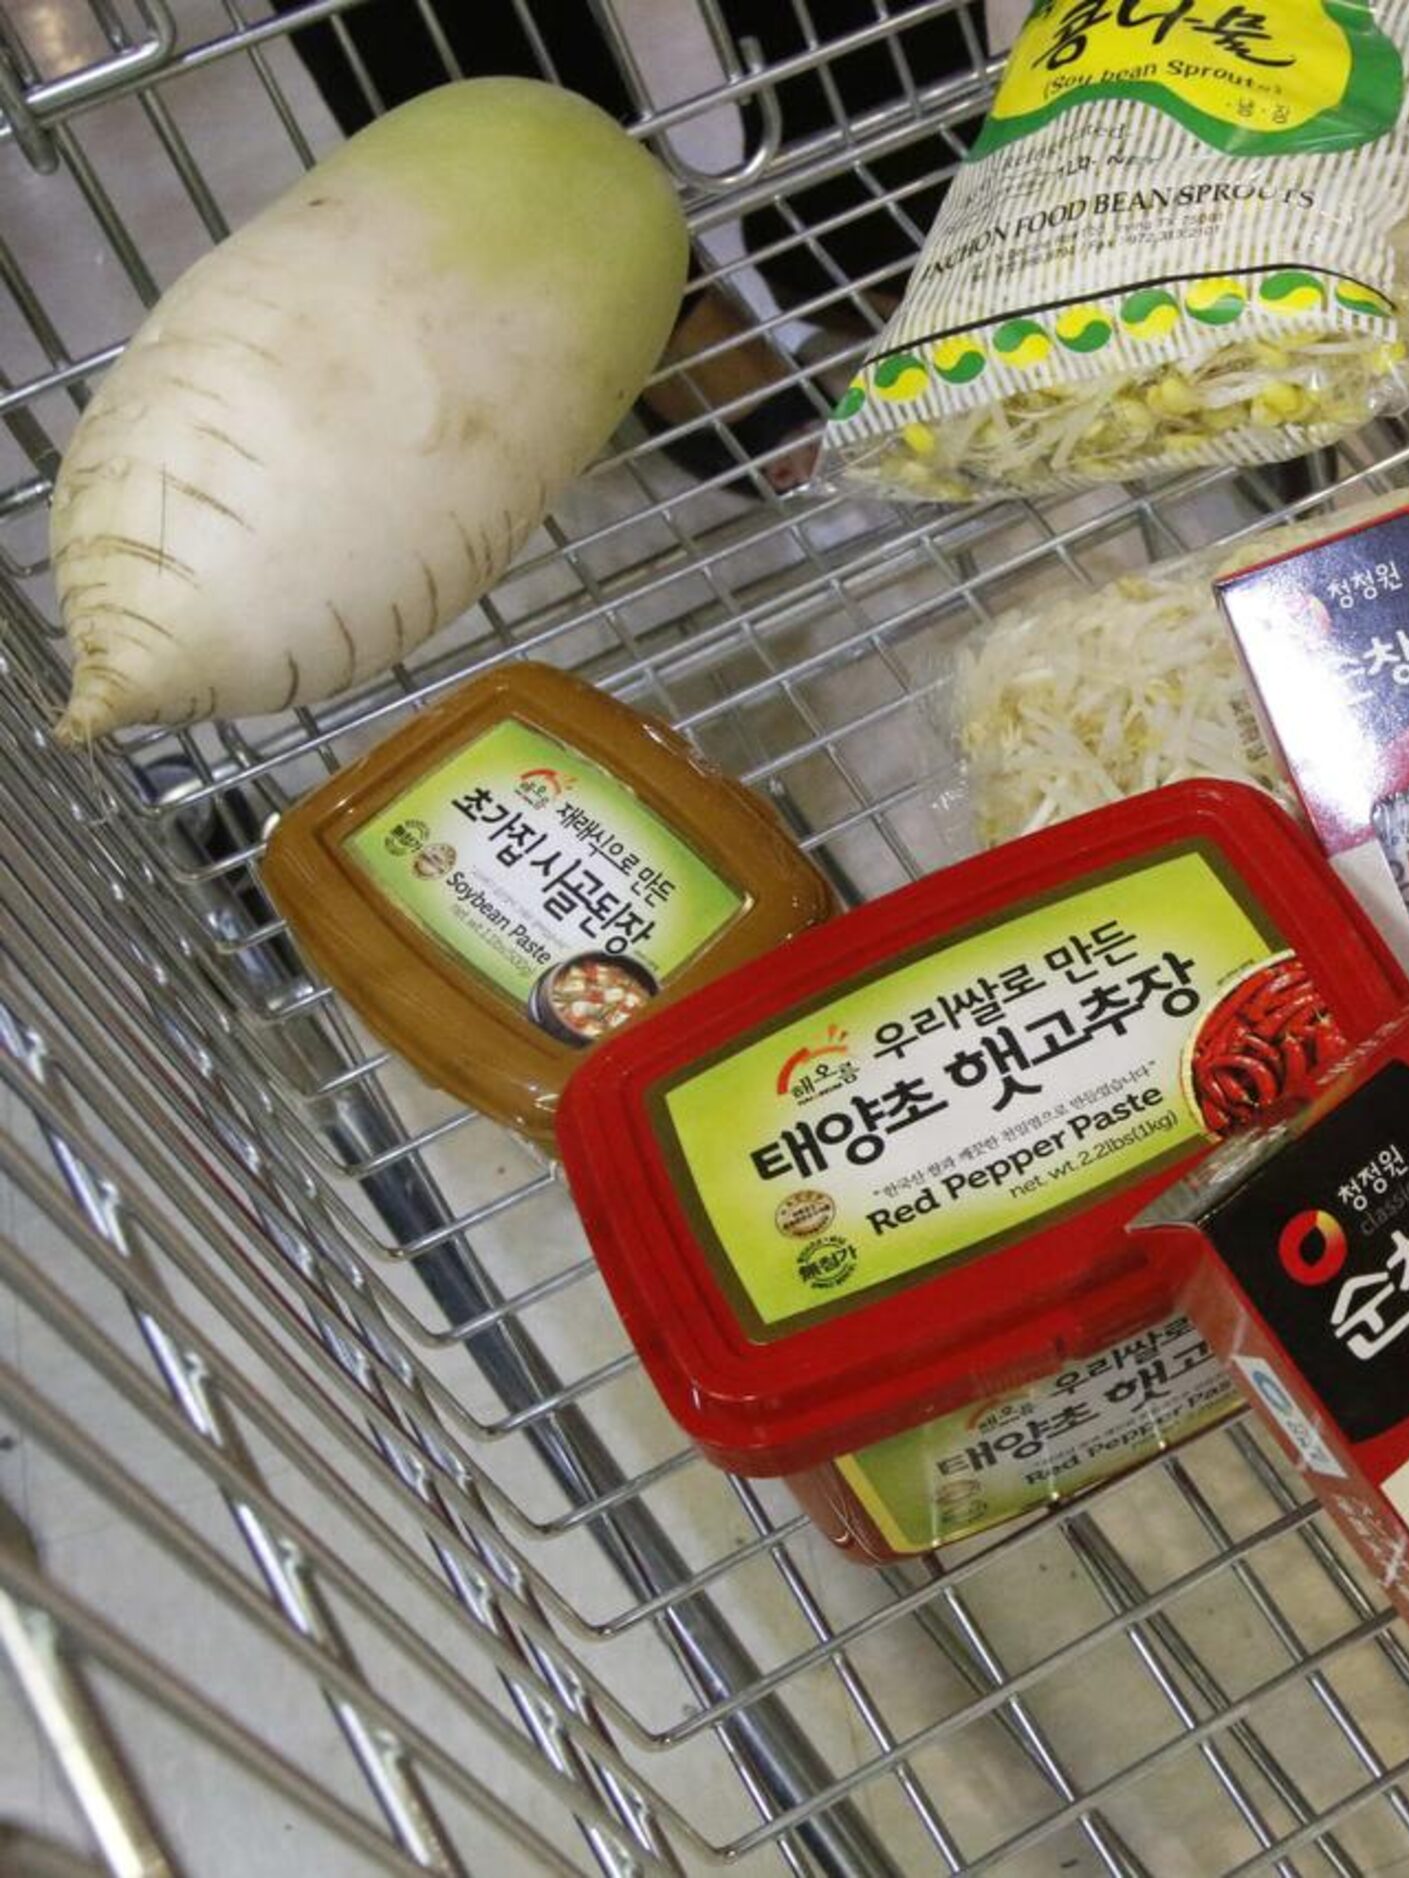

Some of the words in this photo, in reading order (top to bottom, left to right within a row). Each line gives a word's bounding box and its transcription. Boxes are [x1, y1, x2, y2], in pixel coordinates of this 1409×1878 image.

[1014, 201, 1087, 240] FOOD
[1093, 186, 1175, 215] BEAN
[1327, 560, 1404, 609] 청정원
[451, 787, 548, 868] 초가집
[530, 850, 656, 956] 시골된장
[556, 802, 640, 876] 재래식으로
[630, 865, 677, 908] 만든
[446, 870, 511, 932] Soybean
[510, 923, 552, 965] Paste
[873, 962, 1048, 1060] 우리쌀로
[1043, 919, 1139, 985] 만든
[749, 1077, 950, 1183] 태양초
[943, 951, 1200, 1112] 햇고추장
[865, 1188, 942, 1236] Red
[941, 1129, 1068, 1202] Pepper
[1066, 1086, 1165, 1141] Paste
[1337, 1143, 1409, 1211] 청정원
[1049, 1316, 1197, 1399] 우리쌀로
[936, 1401, 1100, 1477] 태양초
[1023, 1453, 1080, 1486] Red
[1087, 1404, 1184, 1458] Pepper
